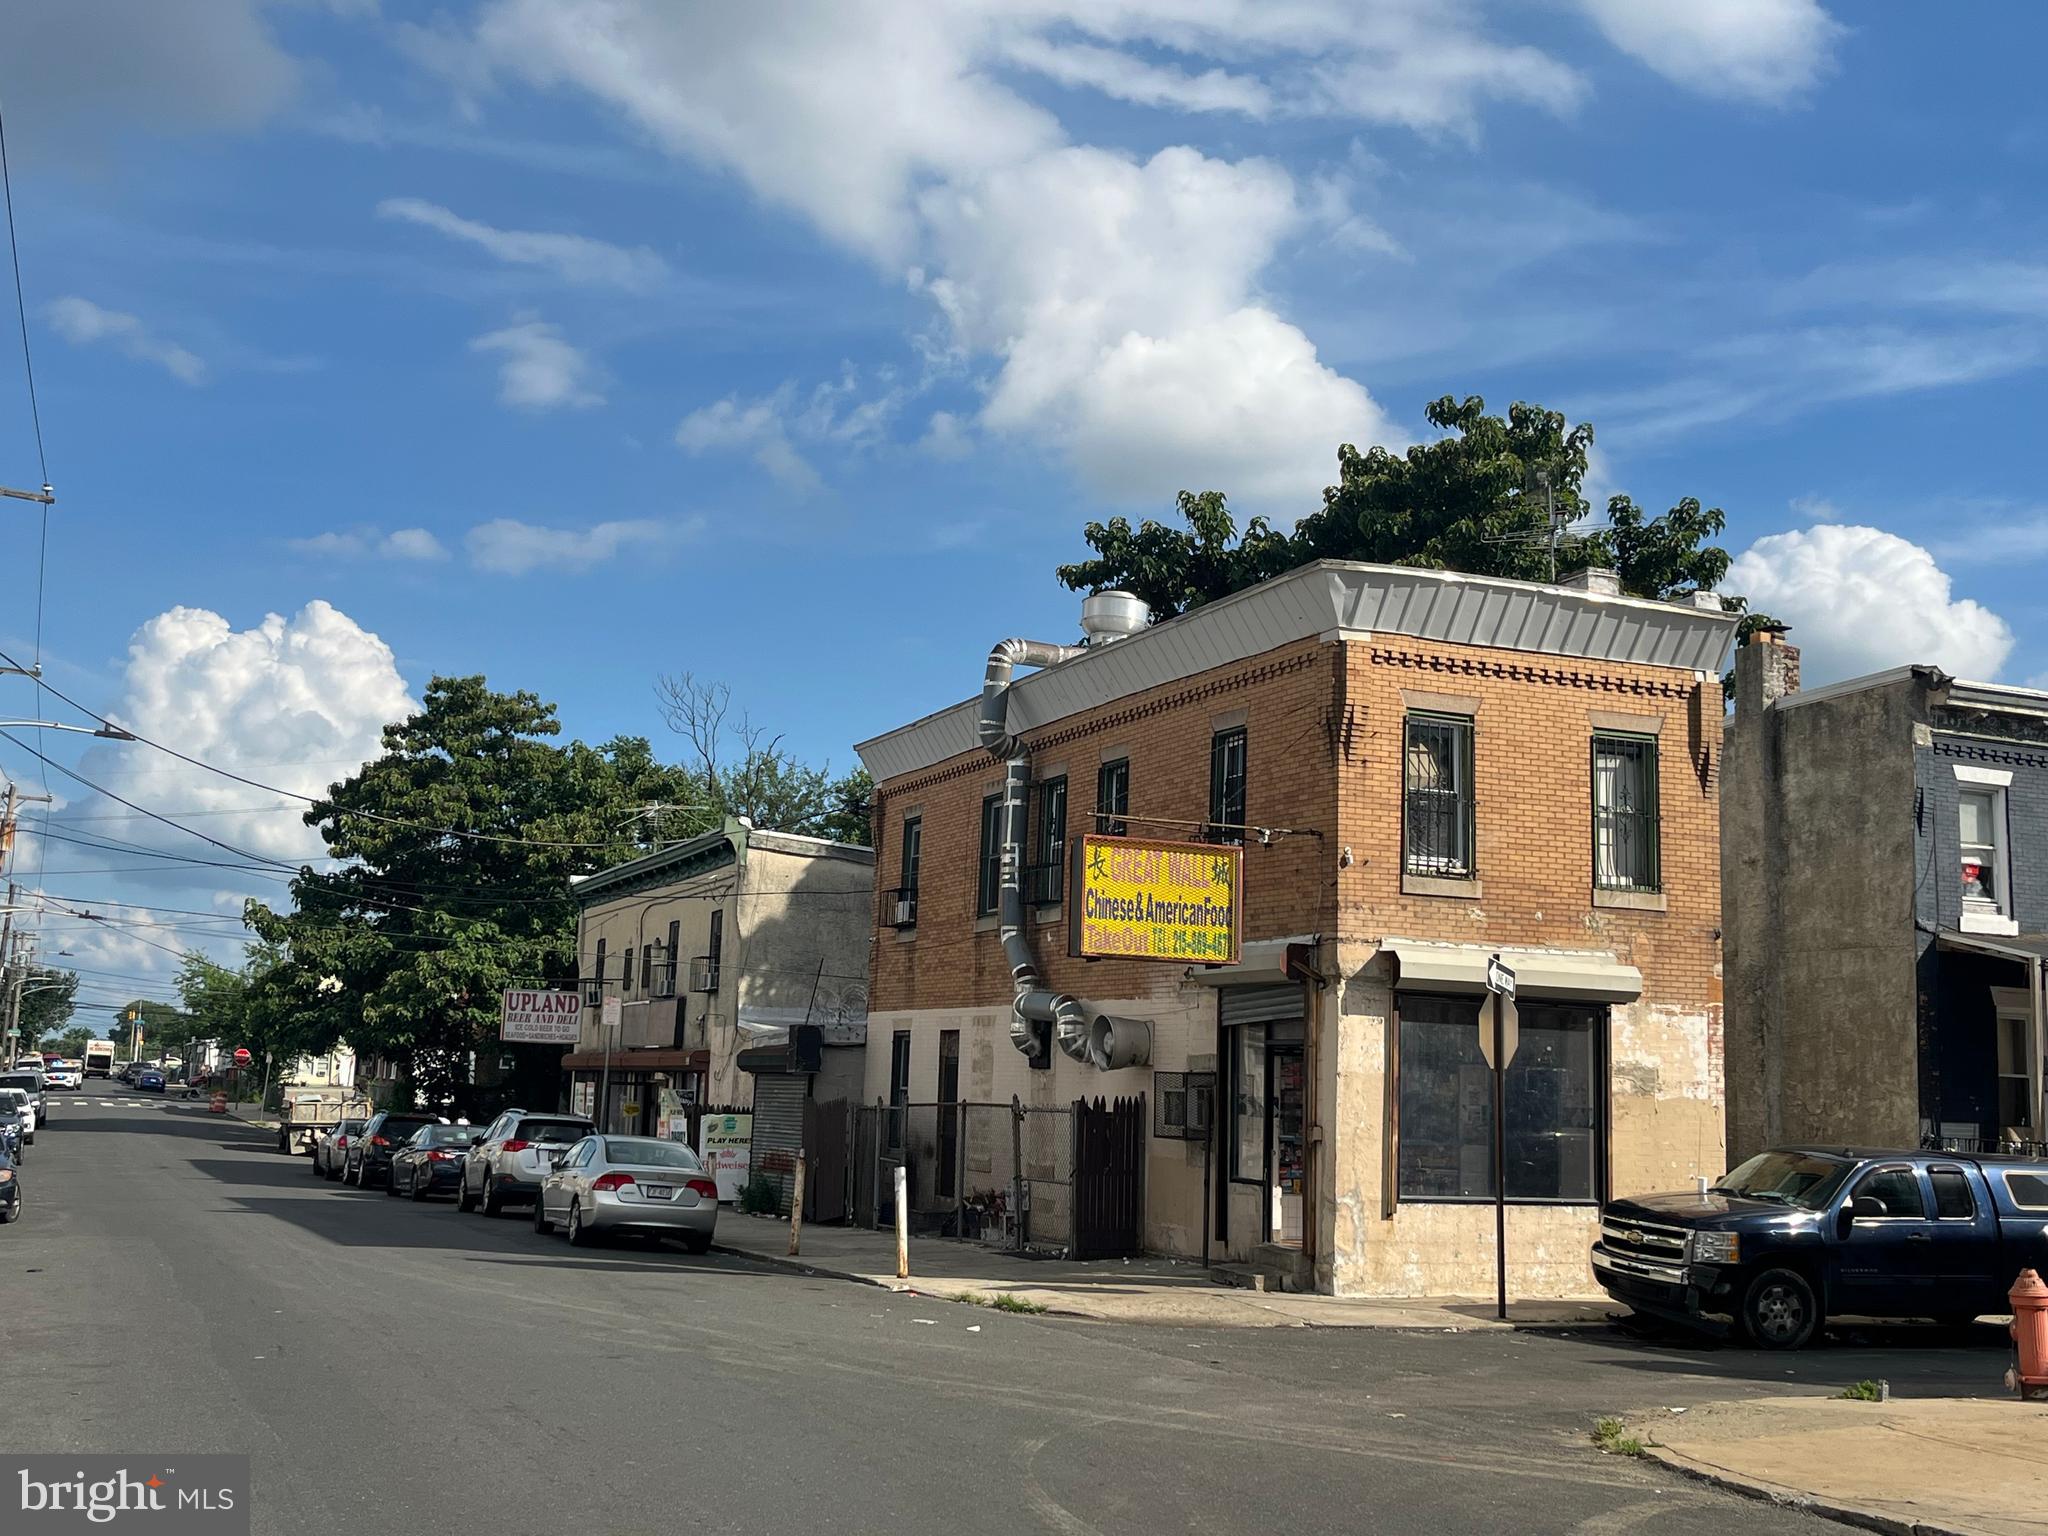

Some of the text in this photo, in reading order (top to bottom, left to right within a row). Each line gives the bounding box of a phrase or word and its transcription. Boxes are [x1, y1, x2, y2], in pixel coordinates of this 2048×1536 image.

[1111, 847, 1211, 889] GREAT WALL
[508, 993, 579, 1014] UPLAND
[507, 1012, 578, 1025] BEER AND DELI
[524, 1024, 538, 1032] COLD
